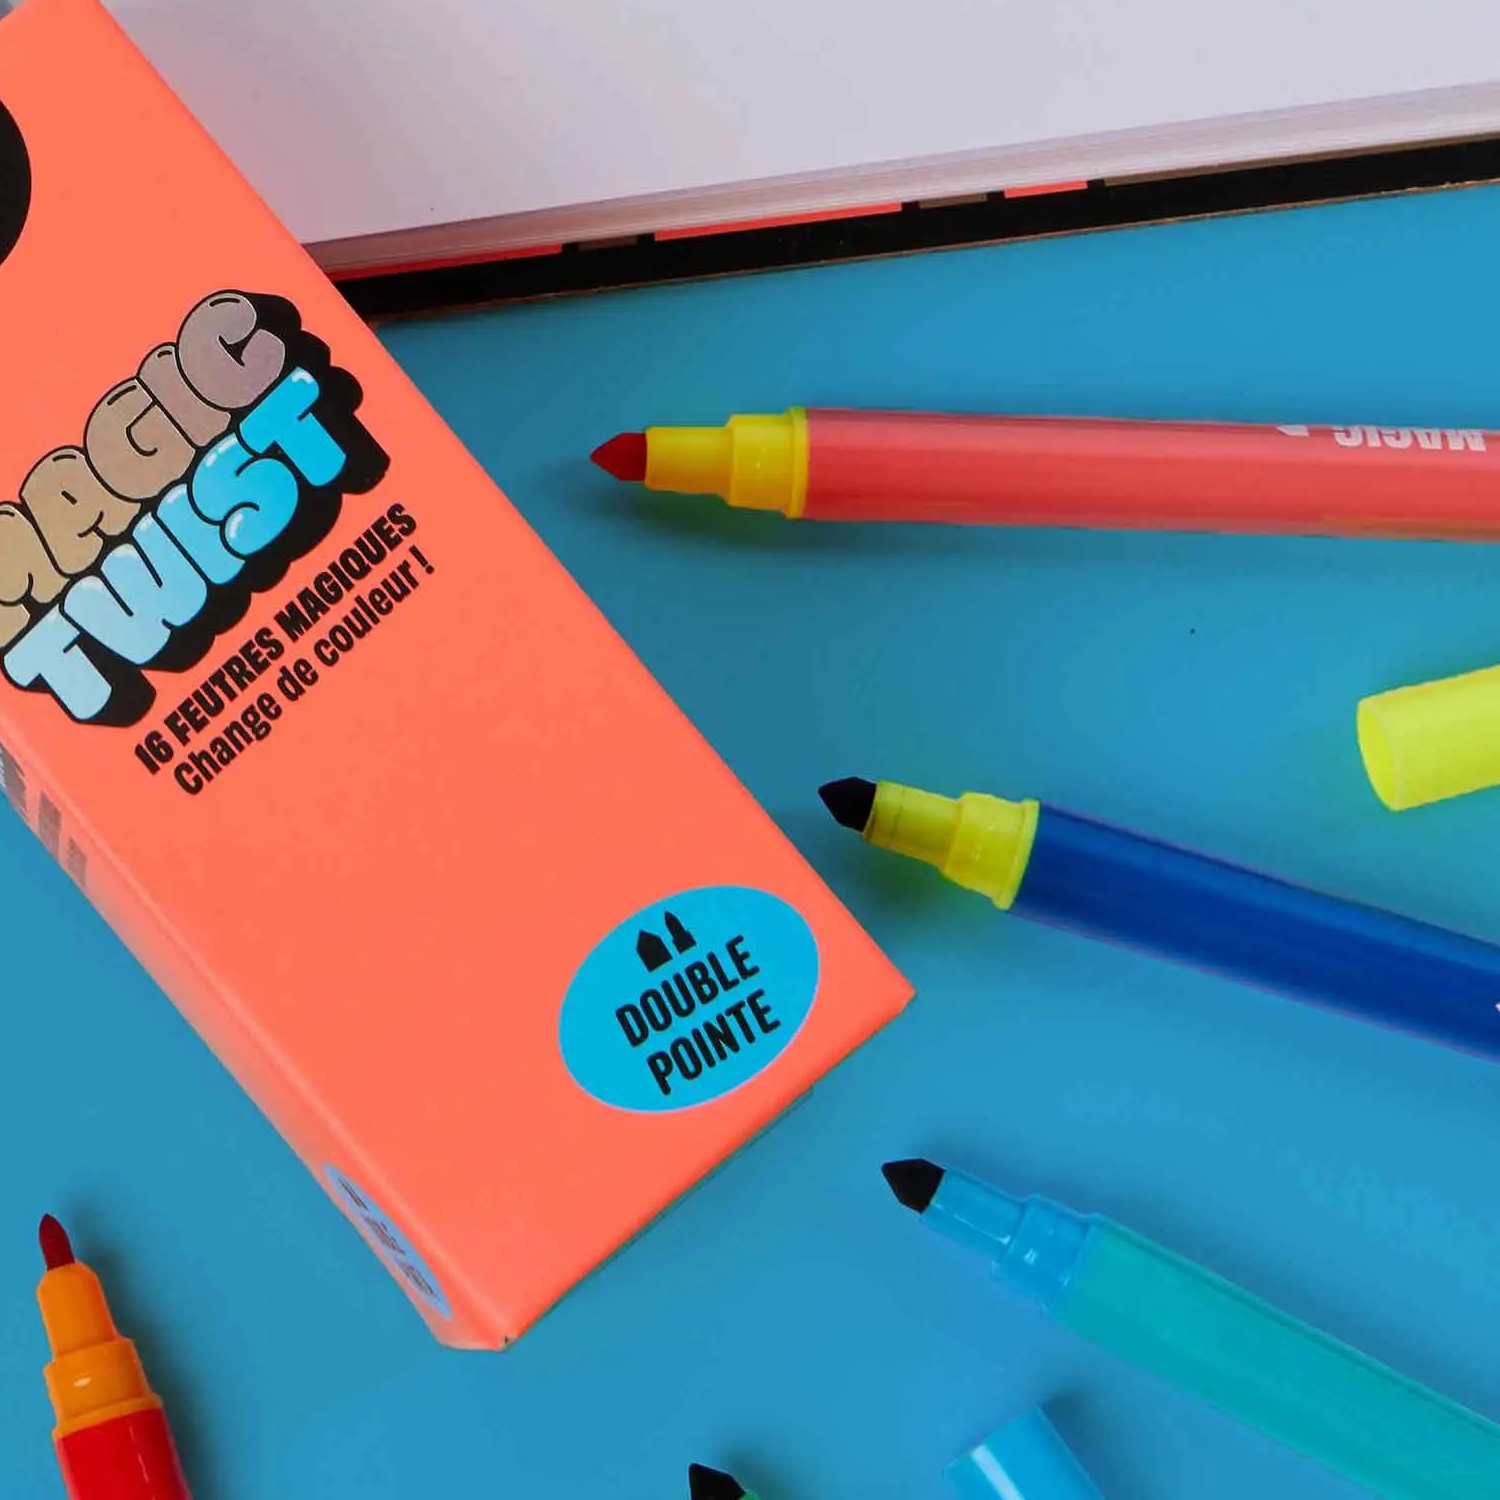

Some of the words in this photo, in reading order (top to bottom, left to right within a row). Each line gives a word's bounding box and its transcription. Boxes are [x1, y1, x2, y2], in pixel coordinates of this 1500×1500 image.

[0, 366, 350, 723] TWIST
[134, 730, 175, 775] 16
[163, 627, 285, 746] FEUTRES
[274, 503, 417, 643] MAGIQUES
[173, 692, 283, 796] Change
[276, 658, 319, 702] de
[615, 934, 760, 1048] DOUBLE
[646, 988, 781, 1096] POINTE
